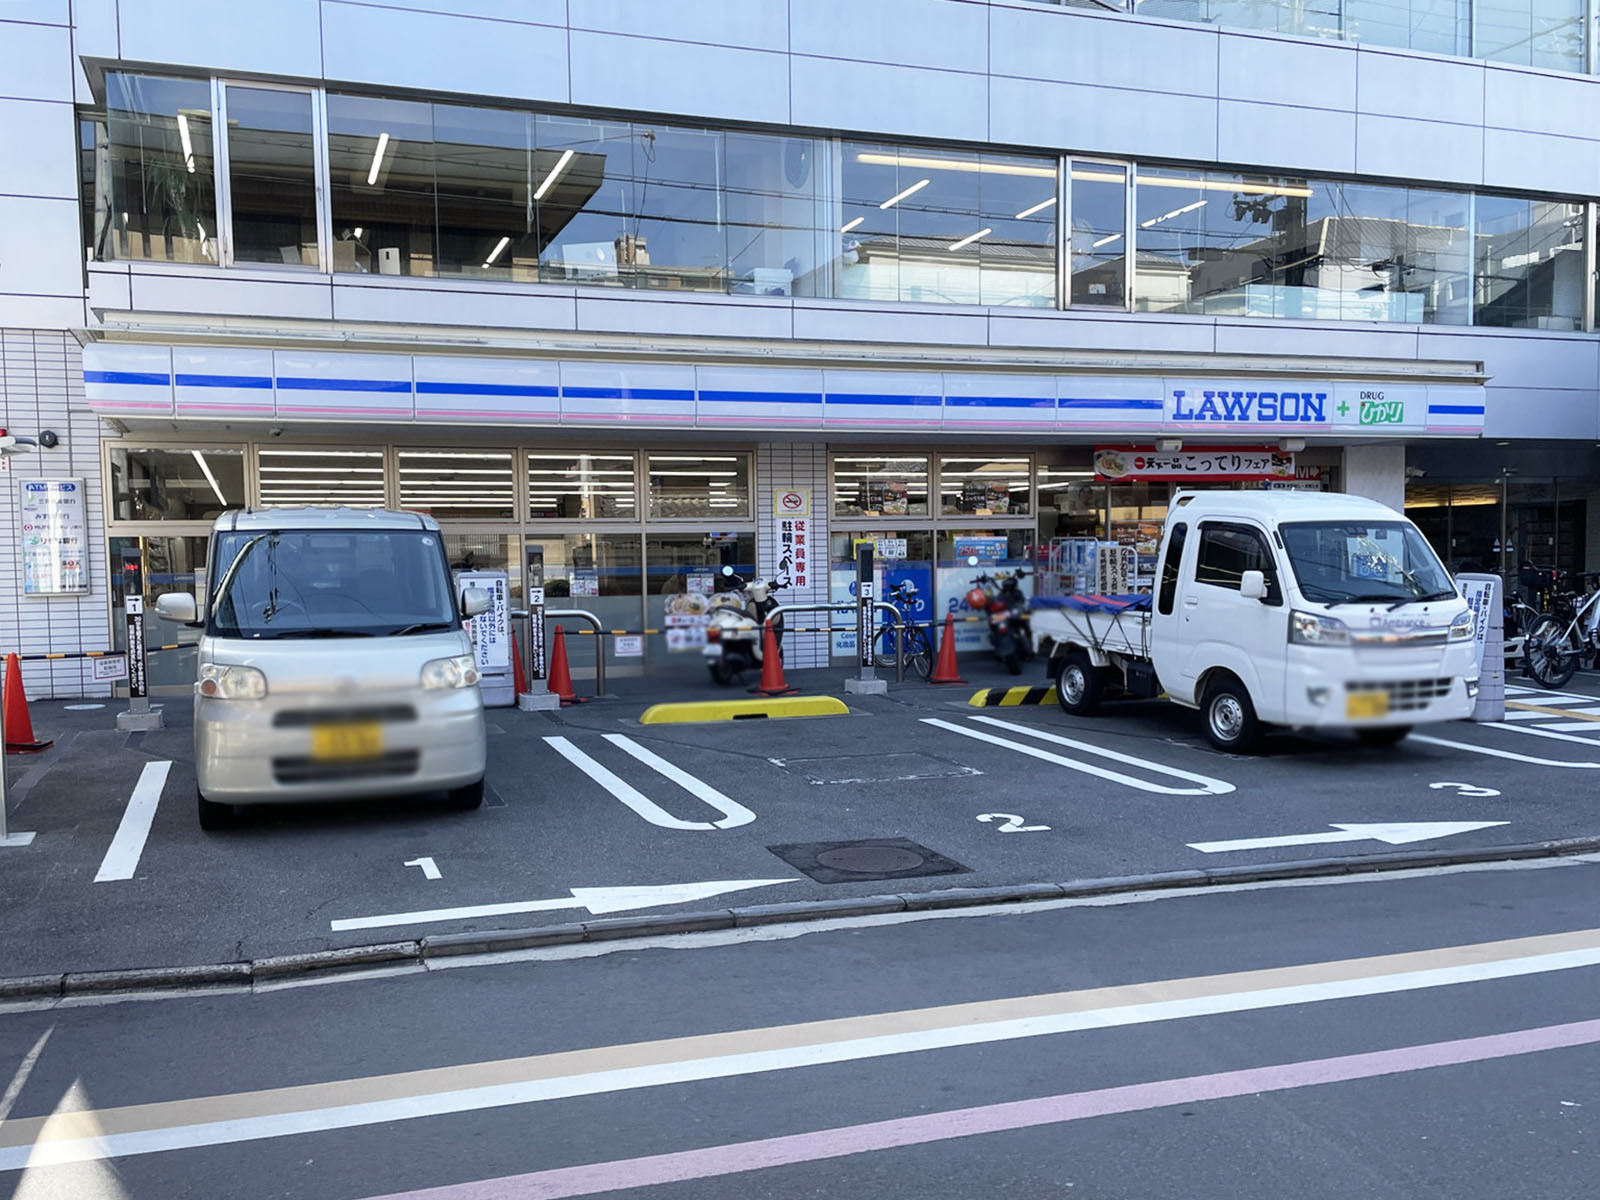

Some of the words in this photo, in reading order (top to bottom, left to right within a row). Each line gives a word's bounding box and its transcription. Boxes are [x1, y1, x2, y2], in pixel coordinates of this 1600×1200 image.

[1360, 391, 1385, 400] DRUG
[1173, 391, 1327, 421] LAWSON
[1361, 402, 1403, 424] ひかり
[781, 521, 793, 587] 駐輪スペース
[794, 521, 805, 587] 従業員専用
[864, 588, 870, 596] 3
[132, 604, 137, 612] 1
[1429, 782, 1501, 797] 3
[976, 813, 1051, 832] 2
[404, 857, 443, 880] 1
